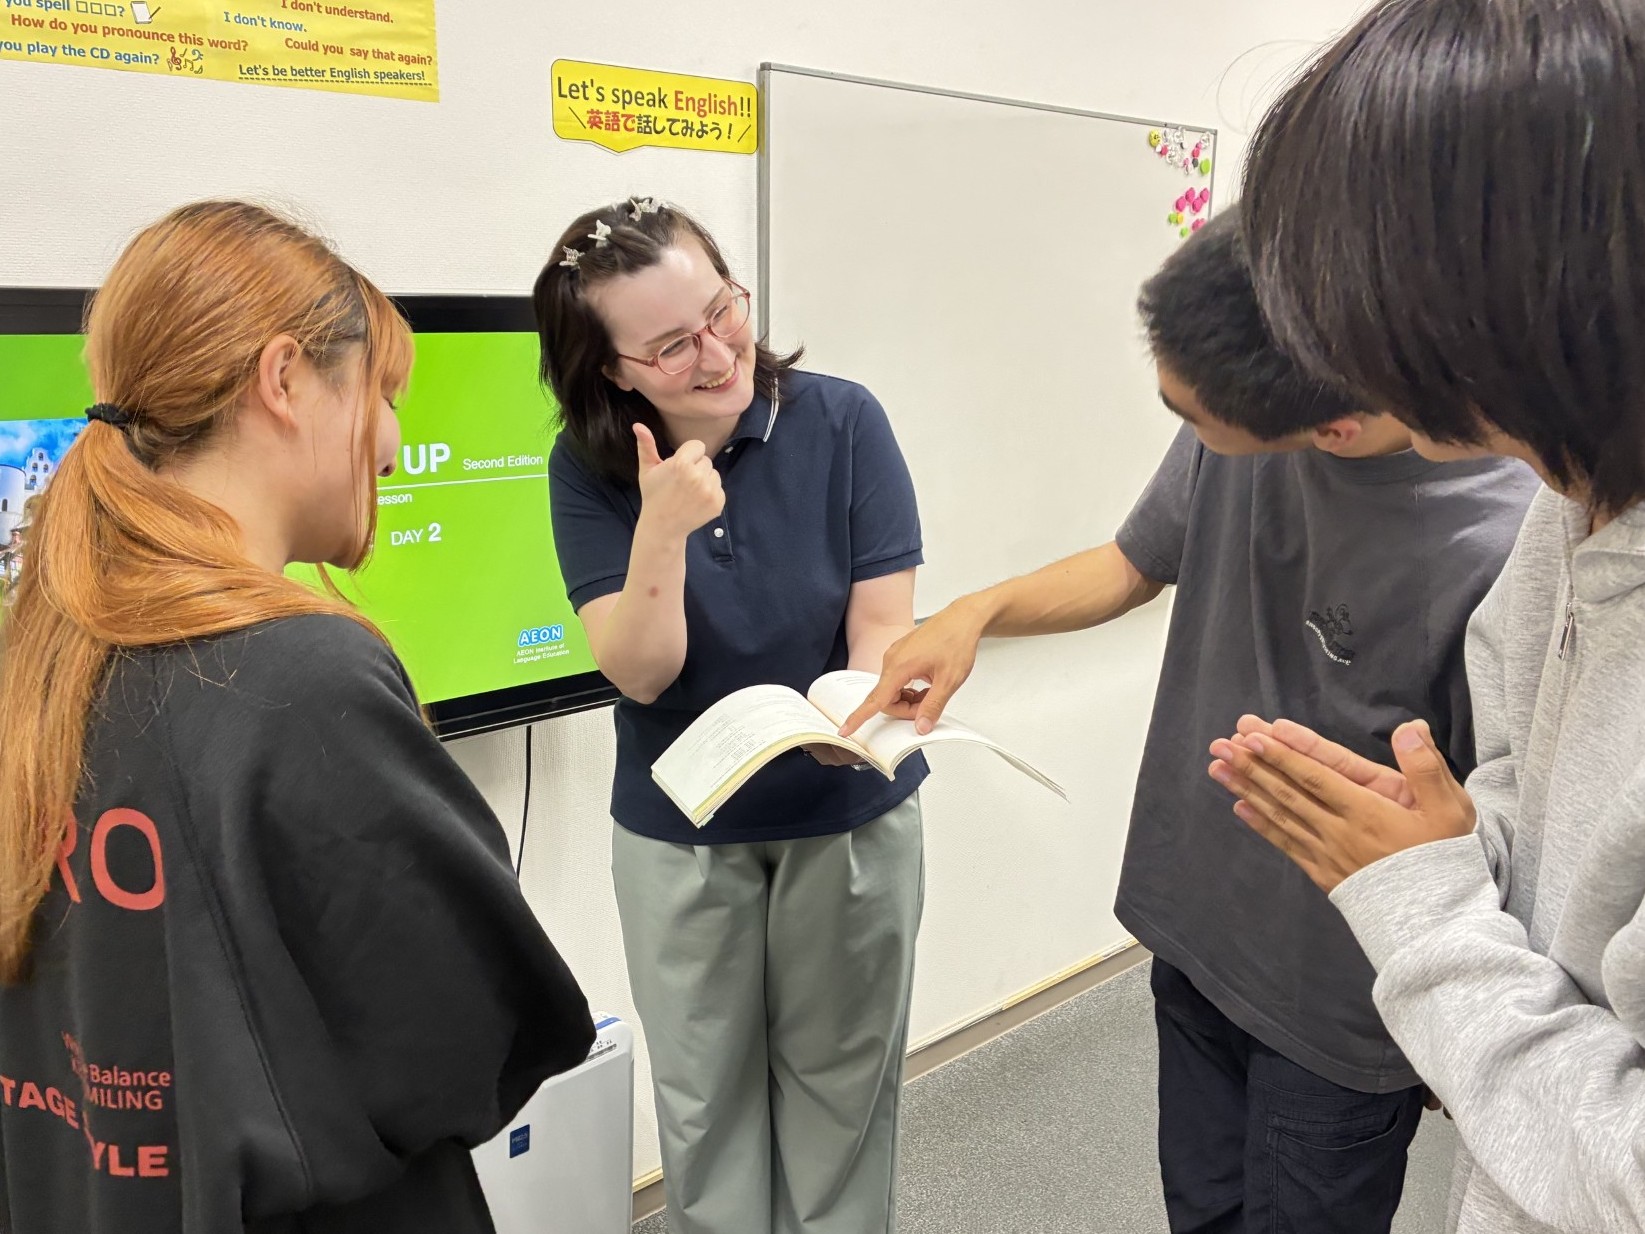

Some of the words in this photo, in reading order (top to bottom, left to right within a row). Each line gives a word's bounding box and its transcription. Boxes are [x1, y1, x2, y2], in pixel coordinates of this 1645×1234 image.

[36, 0, 70, 11] spell
[281, 0, 288, 8] I
[290, 0, 322, 13] don't
[325, 5, 394, 23] understand.
[11, 14, 45, 29] How
[49, 18, 68, 31] do
[71, 22, 98, 35] you
[102, 25, 175, 42] pronounce
[178, 33, 204, 46] this
[207, 38, 249, 51] word?
[224, 11, 231, 23] I
[234, 13, 267, 27] don't
[269, 17, 307, 32] know.
[27, 42, 57, 57] play
[62, 44, 86, 57] the
[90, 47, 110, 59] CD
[115, 51, 159, 64] again?
[285, 37, 319, 51] Could
[322, 43, 344, 56] you
[349, 47, 369, 59] say
[372, 48, 396, 62] that
[398, 53, 433, 66] again?
[239, 64, 269, 76] Let's
[272, 64, 288, 76] be
[290, 66, 326, 78] better
[330, 67, 371, 81] English
[373, 69, 425, 81] speakers!
[557, 76, 605, 102] Let's
[611, 87, 668, 110] speak
[674, 90, 751, 118] English!!
[403, 443, 451, 475] UP
[463, 457, 505, 471] Second
[507, 454, 544, 468] Edition
[391, 529, 423, 546] DAY
[428, 522, 442, 542] 2
[519, 625, 562, 646] AEON
[516, 648, 534, 657] AEON
[88, 1063, 172, 1087] Balance
